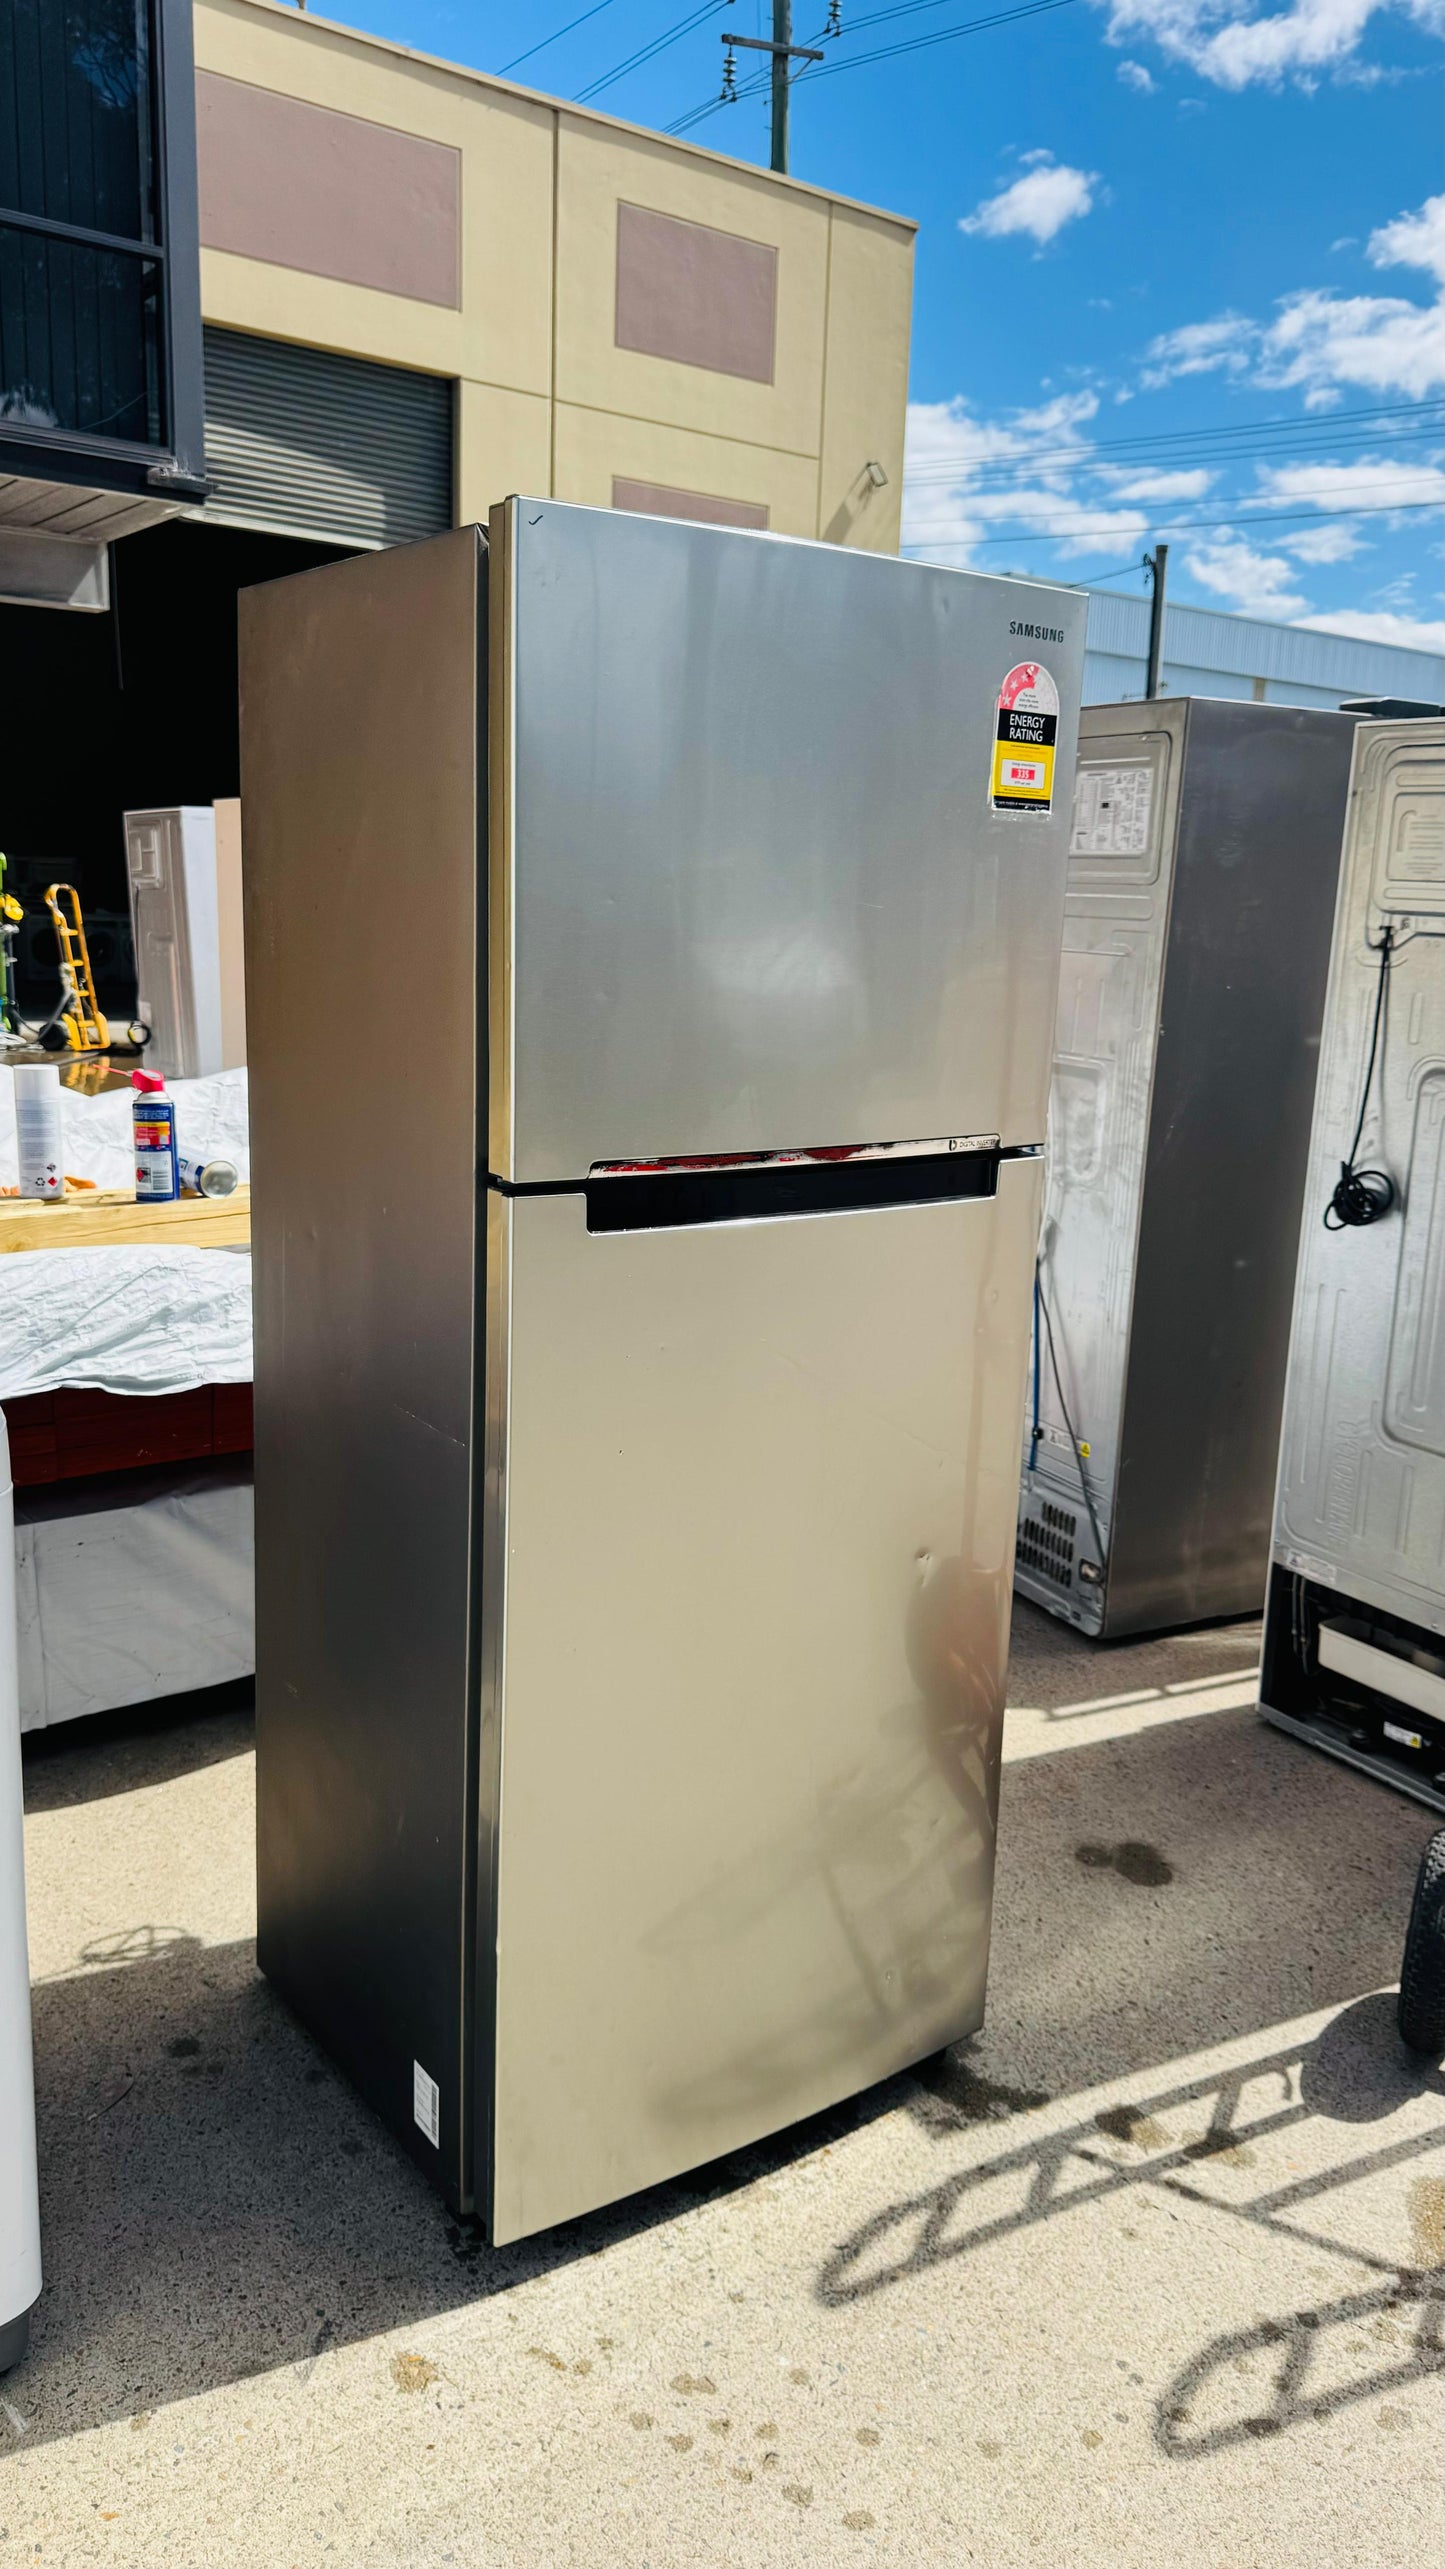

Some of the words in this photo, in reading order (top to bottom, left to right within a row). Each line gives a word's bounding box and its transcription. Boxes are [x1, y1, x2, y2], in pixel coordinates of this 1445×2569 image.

[1009, 620, 1064, 643] SAMSUNG
[1009, 713, 1045, 729] ENERGY
[1009, 727, 1043, 742] RATING
